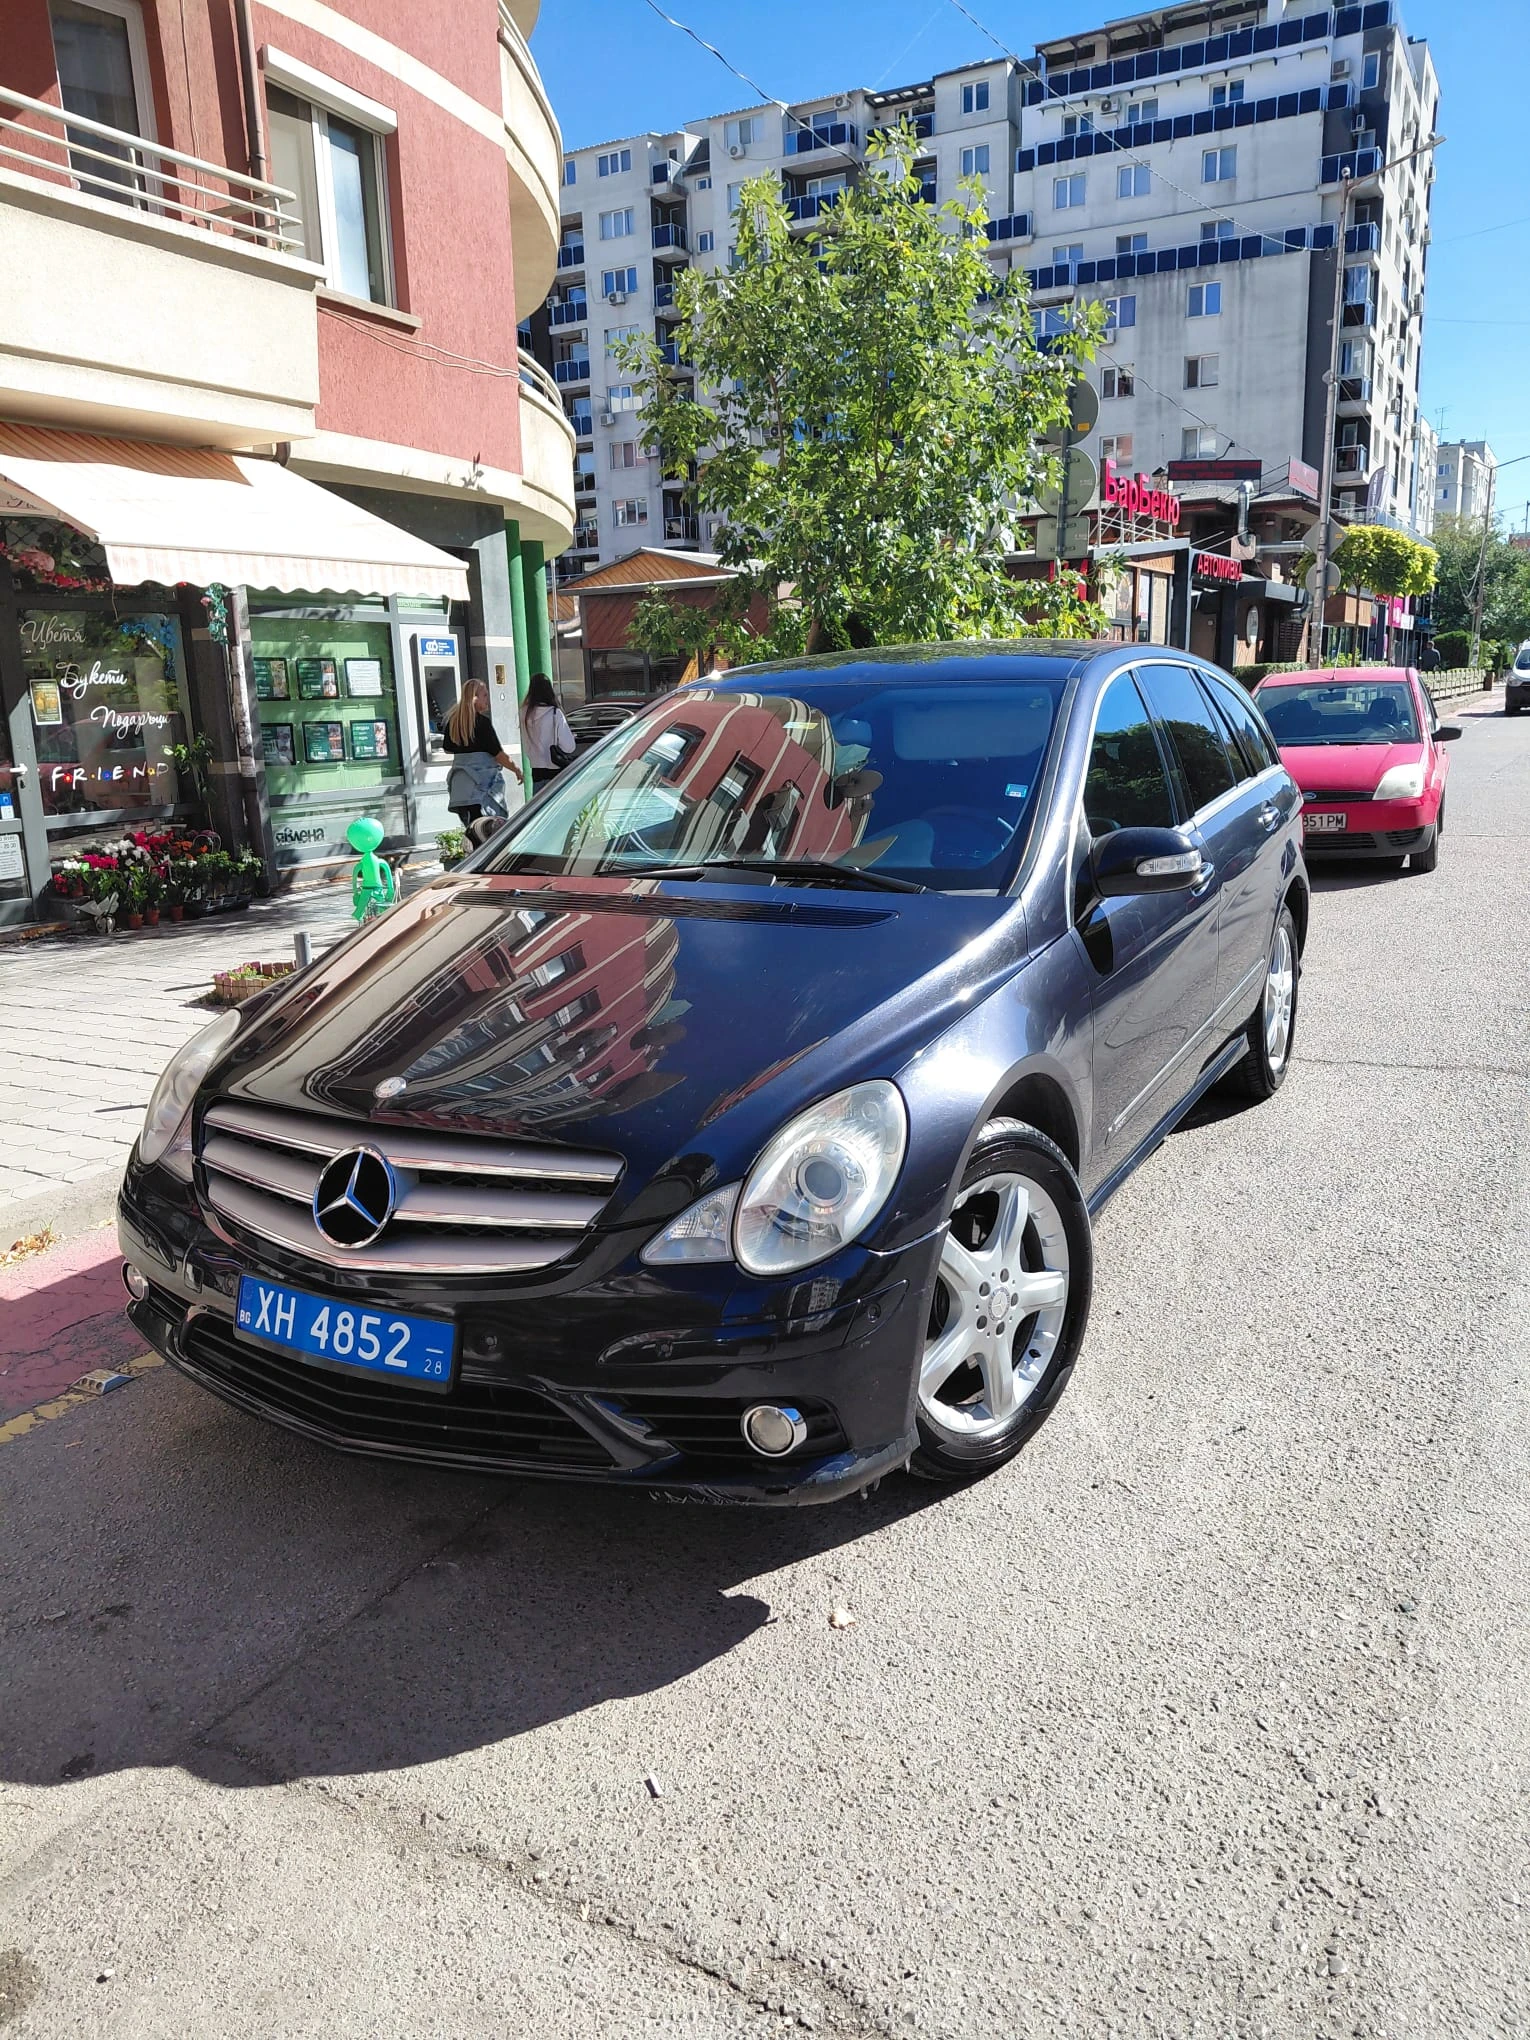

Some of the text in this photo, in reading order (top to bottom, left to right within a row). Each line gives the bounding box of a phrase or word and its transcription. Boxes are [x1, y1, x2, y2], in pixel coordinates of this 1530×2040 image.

[1197, 553, 1243, 581] АВТОМИВКА
[21, 616, 86, 649] Цветя
[56, 661, 128, 700] Букети
[91, 706, 170, 739] Подаръци
[1327, 815, 1344, 828] PM
[239, 1309, 251, 1325] BG
[255, 1286, 411, 1369] XH 4852
[423, 1358, 442, 1375] 28
